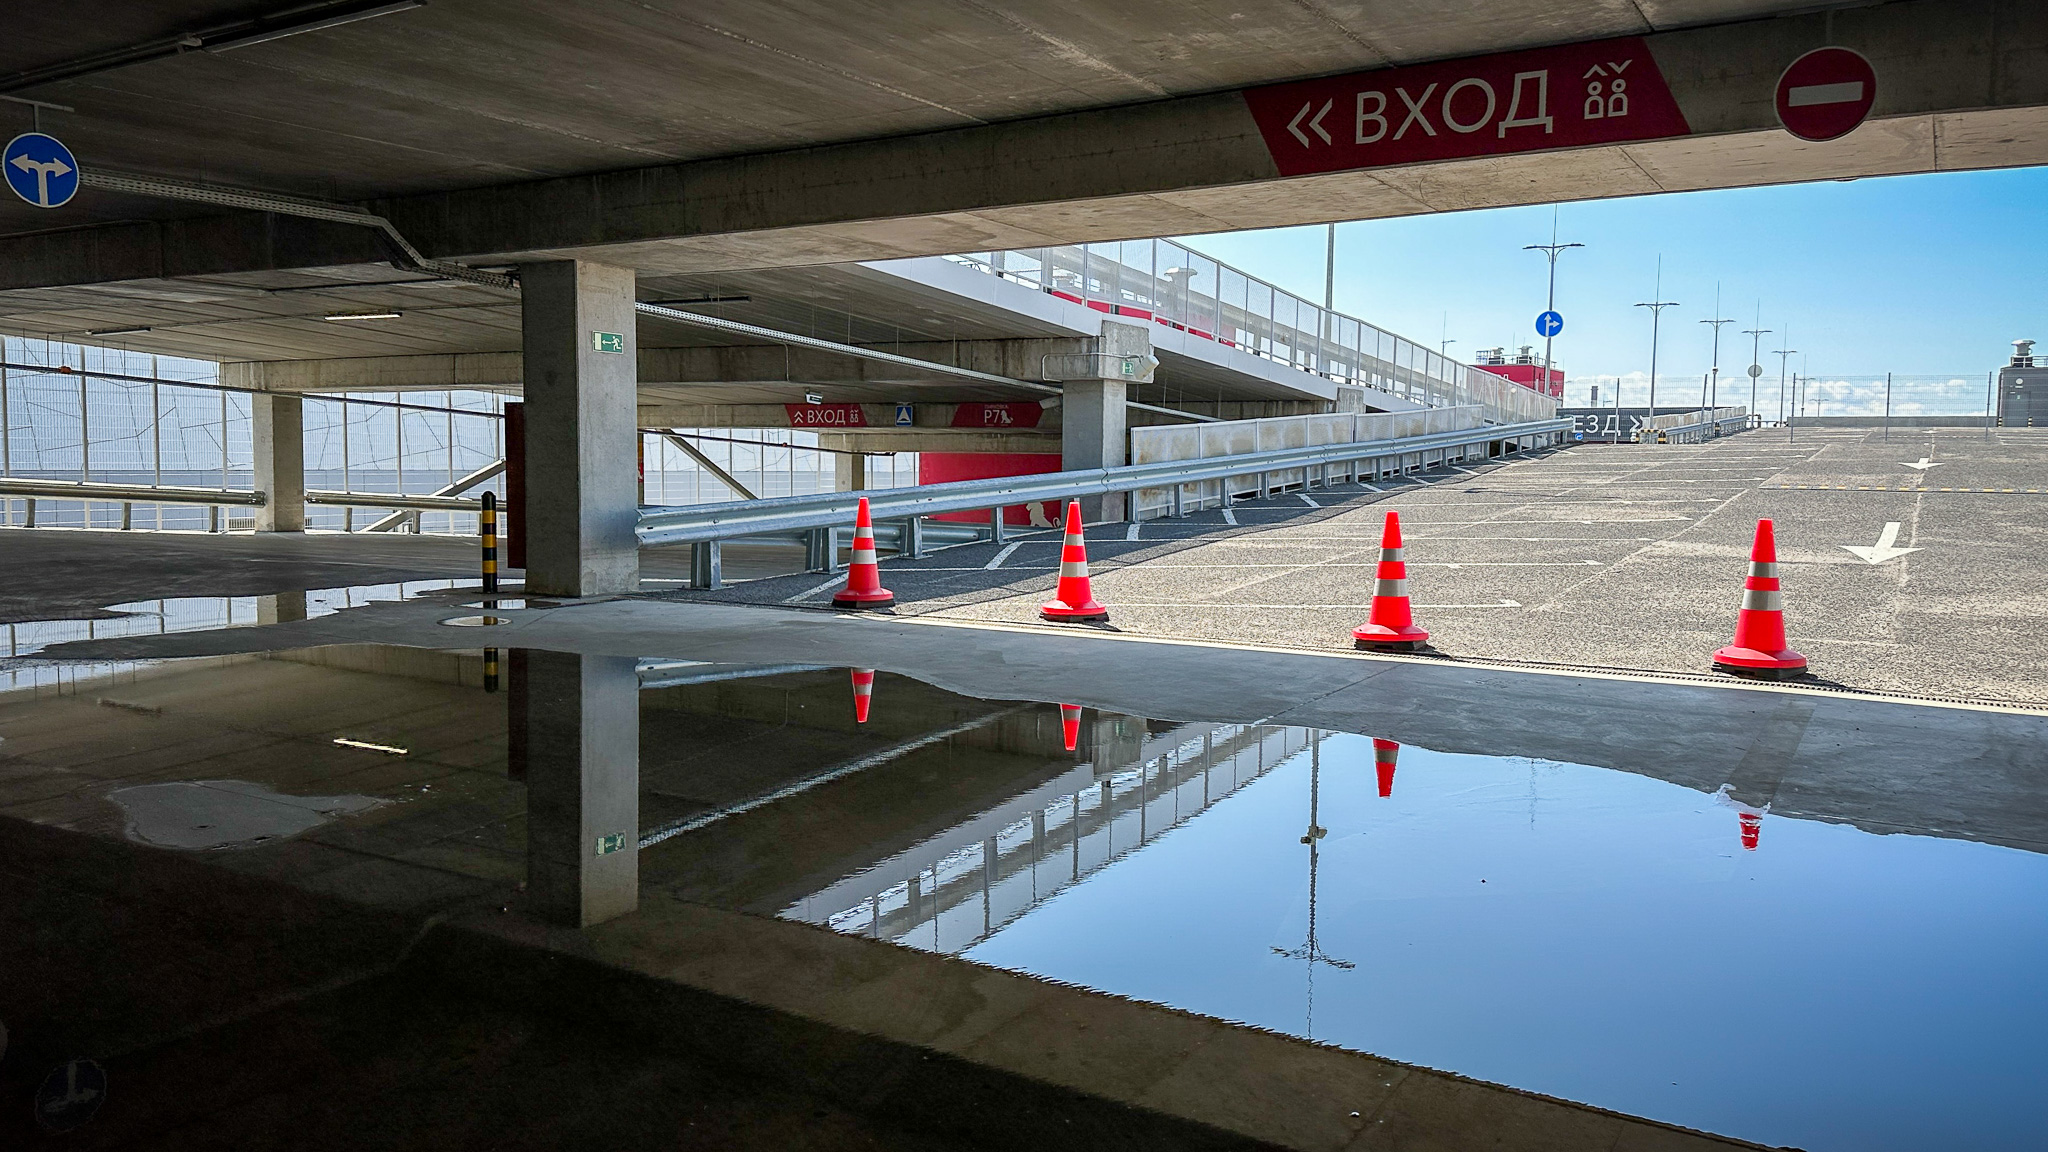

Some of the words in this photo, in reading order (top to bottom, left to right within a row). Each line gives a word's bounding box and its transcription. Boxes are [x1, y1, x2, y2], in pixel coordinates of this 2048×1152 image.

[1354, 69, 1554, 145] ВХОД
[807, 409, 846, 426] ВХОД
[984, 409, 1000, 424] P7
[1571, 414, 1622, 437] ЕЗД
